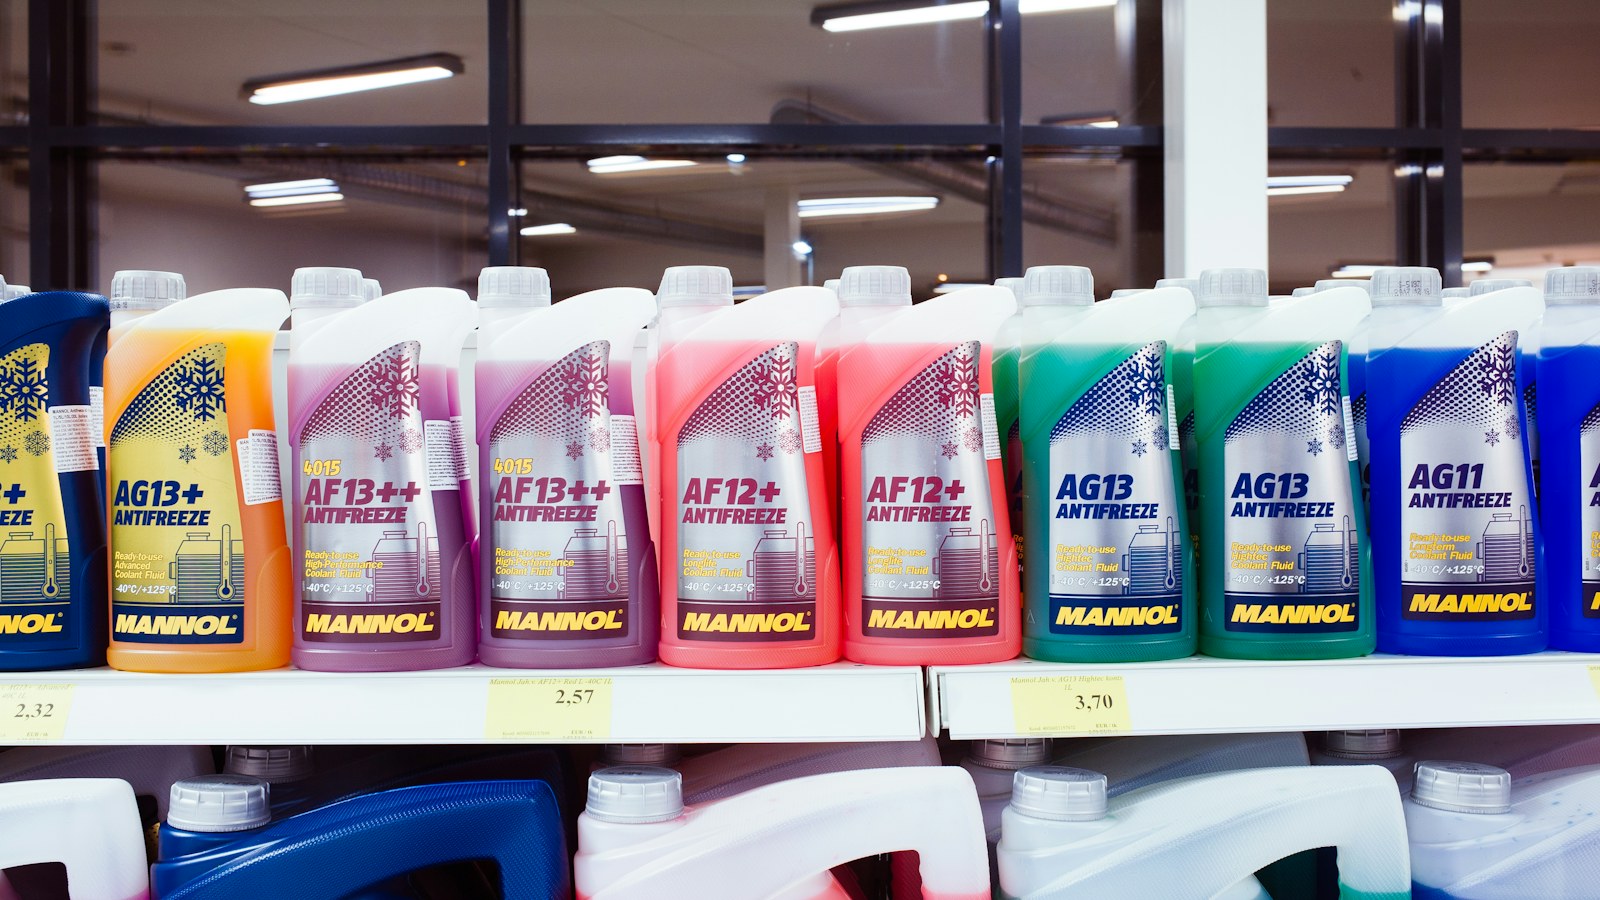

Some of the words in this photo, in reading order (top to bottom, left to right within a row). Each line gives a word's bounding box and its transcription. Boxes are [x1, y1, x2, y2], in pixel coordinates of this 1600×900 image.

[303, 459, 341, 476] 4015
[494, 458, 534, 476] 4015
[1408, 463, 1485, 490] AG11
[113, 480, 204, 507] AG13+
[1056, 474, 1134, 501] AG13
[1230, 473, 1310, 499] AG13
[1408, 492, 1512, 509] ANTIFREEZE
[113, 510, 210, 526] ANTIFREEZE
[304, 507, 408, 524] ANTIFREEZE
[494, 505, 598, 522] ANTIFREEZE
[682, 508, 787, 525] ANTIFREEZE
[866, 506, 971, 523] ANTIFREEZE
[1056, 503, 1159, 520] ANTIFREEZE
[1230, 502, 1335, 518] ANTIFREEZE
[115, 551, 163, 563] Ready-to-use
[305, 550, 359, 562] Ready-to-use
[496, 547, 551, 560] Ready-to-use
[683, 549, 740, 561] Ready-to-use
[115, 561, 150, 571] Advanced
[305, 559, 384, 571] High-Performance
[496, 557, 575, 569] High-Performance
[496, 566, 528, 576] Coolant
[530, 567, 554, 576] Fluid
[683, 559, 717, 570] Longlife
[115, 569, 142, 579] Coolant
[145, 570, 165, 580] Fluid
[305, 569, 336, 578] Coolant
[339, 569, 362, 578] Fluid
[683, 567, 717, 577] Coolant
[719, 567, 742, 578] Fluid
[0, 614, 62, 634] NOL
[555, 689, 594, 707] 2,57
[1075, 695, 1113, 712] 3,70
[14, 703, 55, 721] 2,32
